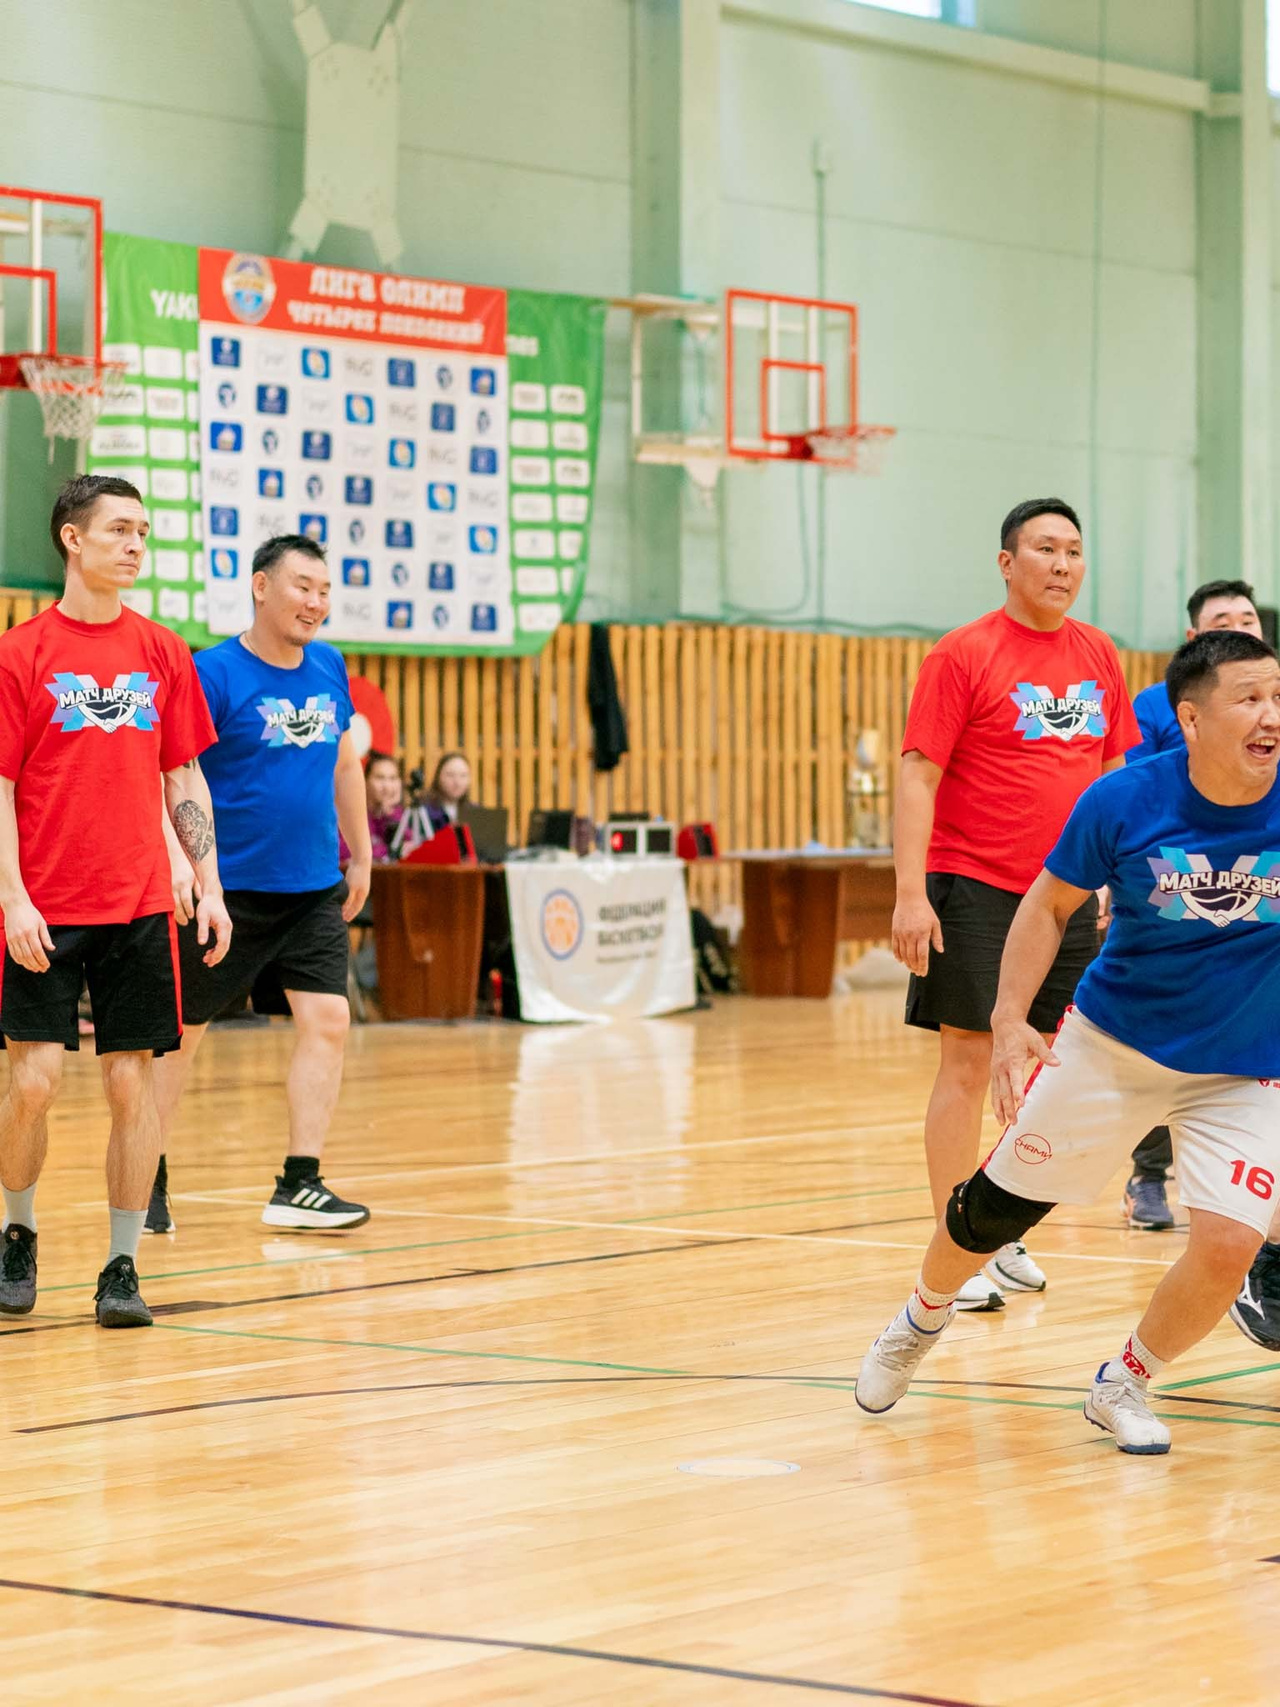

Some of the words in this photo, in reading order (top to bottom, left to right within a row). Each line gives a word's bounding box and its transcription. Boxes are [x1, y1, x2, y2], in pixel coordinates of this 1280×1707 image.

[59, 687, 100, 709] МАТЧ
[102, 687, 152, 708] ДРУЗЕЙ
[1021, 698, 1055, 717] МАТЧ
[1057, 698, 1100, 715] ДРУЗЕЙ
[266, 709, 297, 728] МАТЧ
[1159, 871, 1213, 892] МАТЧ
[1230, 1159, 1275, 1201] 16
